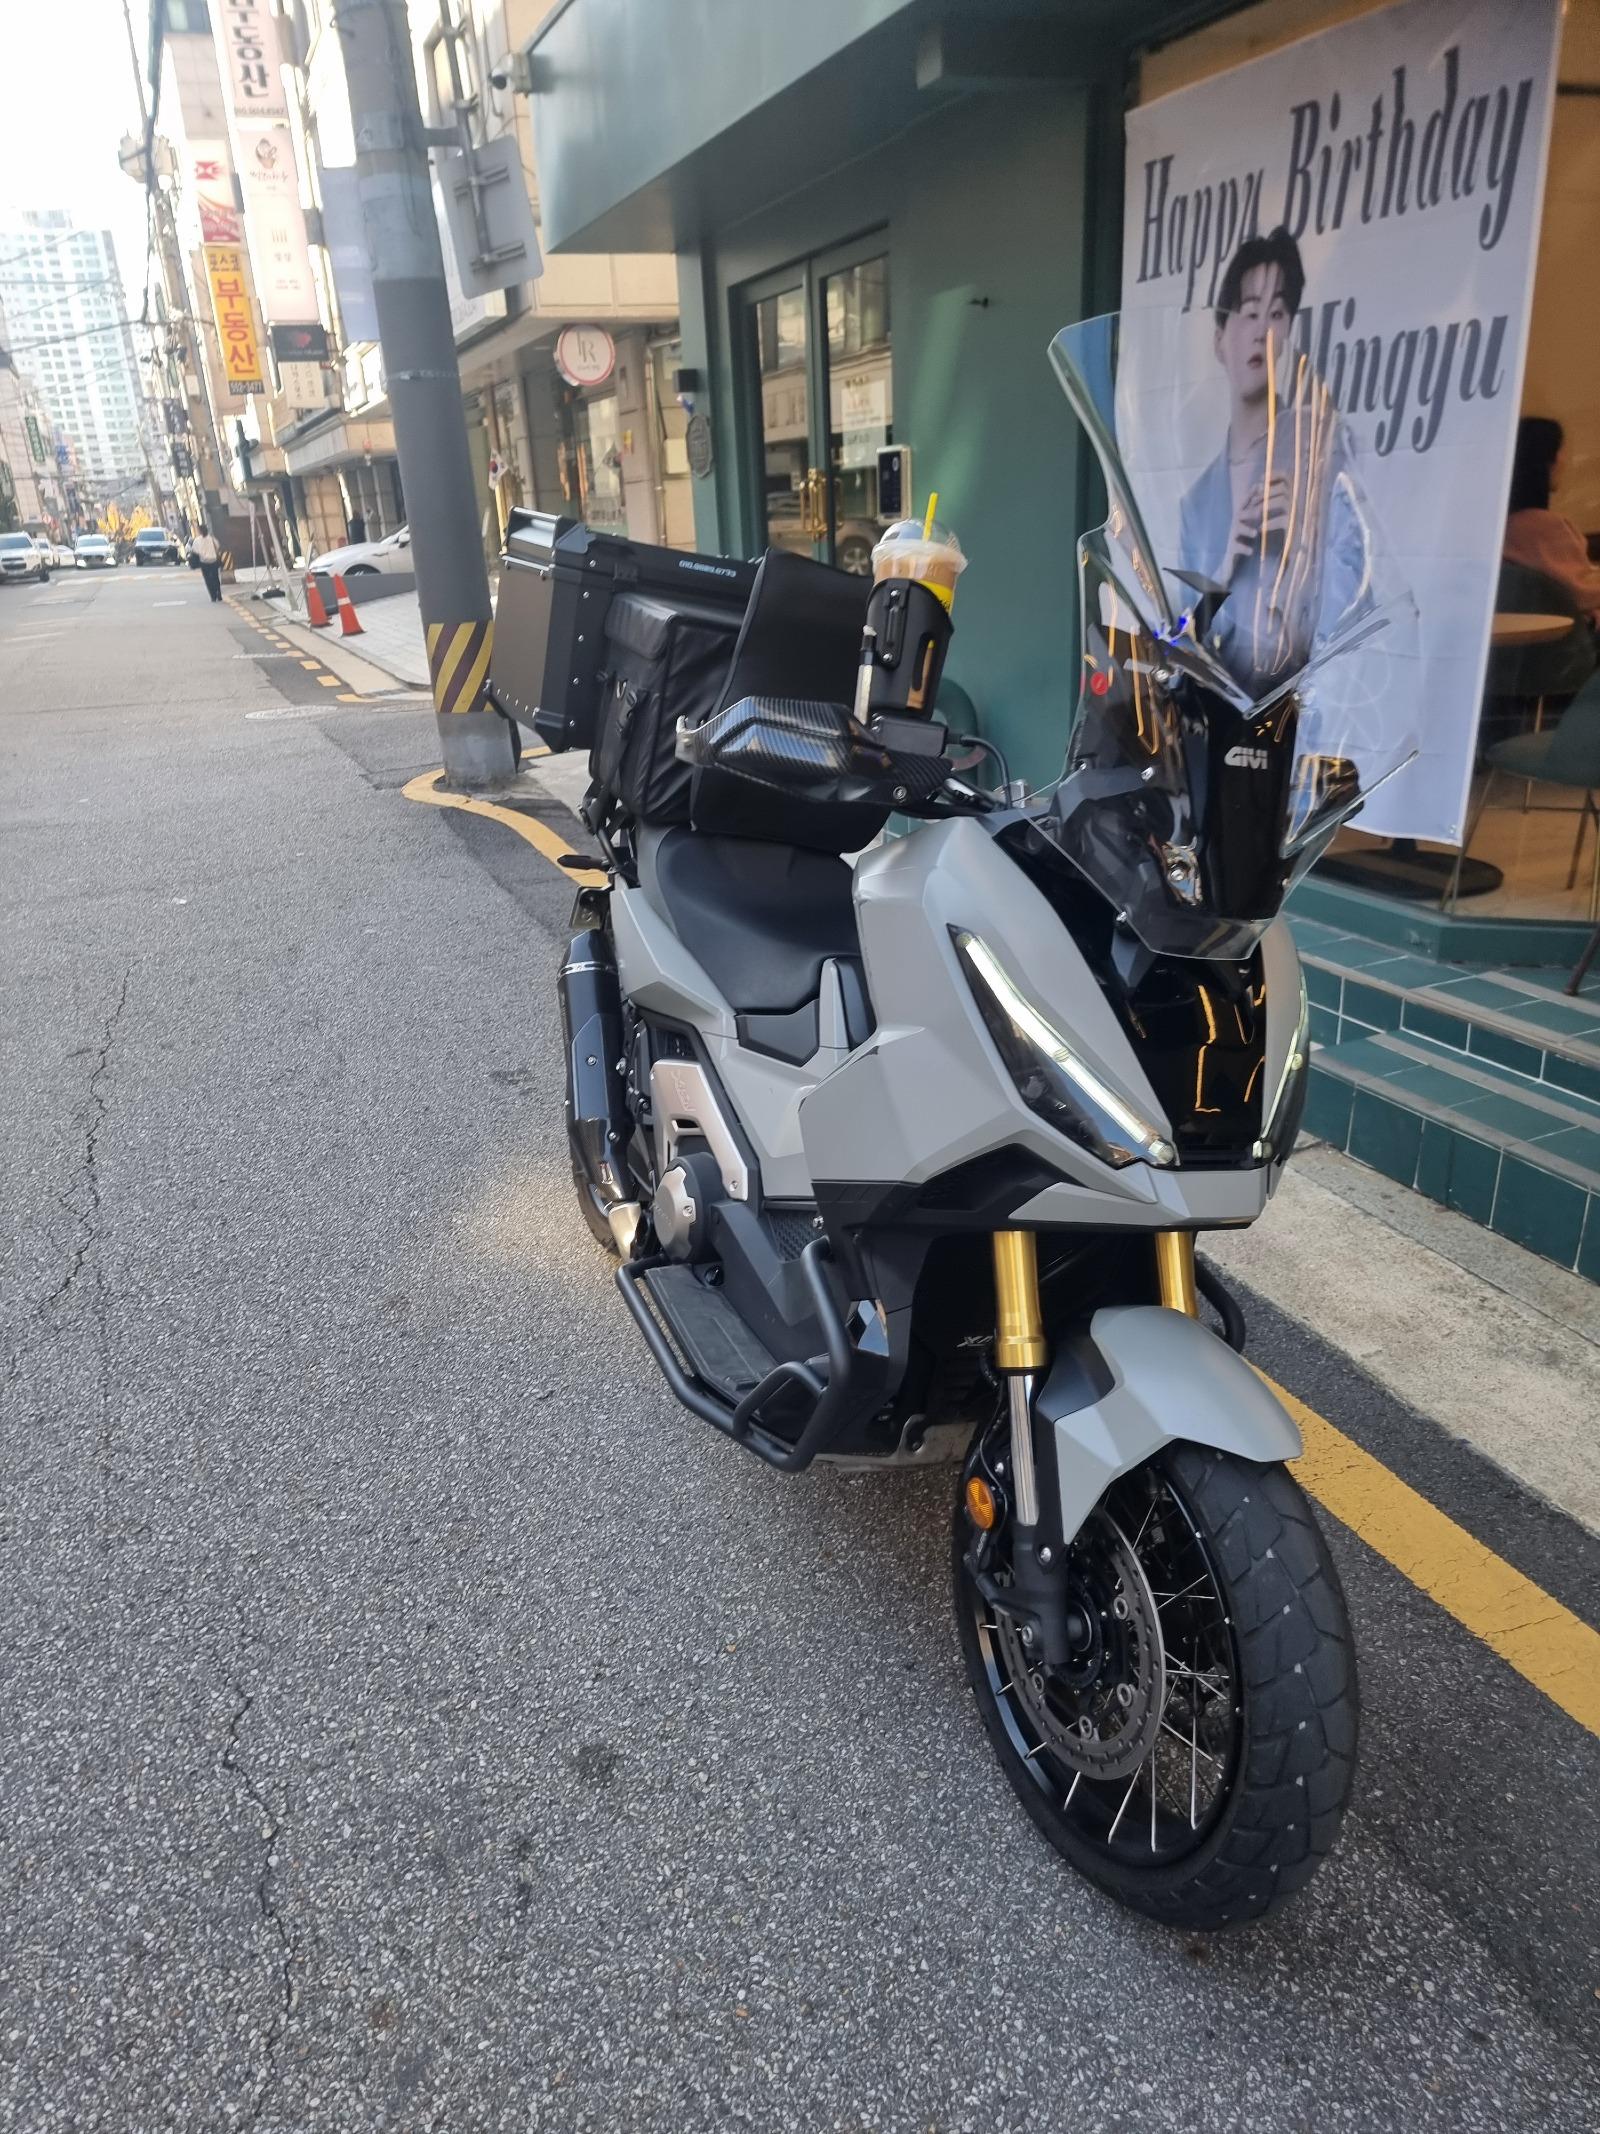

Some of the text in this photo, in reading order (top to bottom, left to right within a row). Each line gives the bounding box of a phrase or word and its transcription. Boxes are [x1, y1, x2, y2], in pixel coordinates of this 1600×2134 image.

[1136, 44, 1533, 314] Happy Birthday
[216, 278, 254, 374] 부동산
[1285, 296, 1509, 457] Mingyu
[1224, 745, 1268, 770] GIVI
